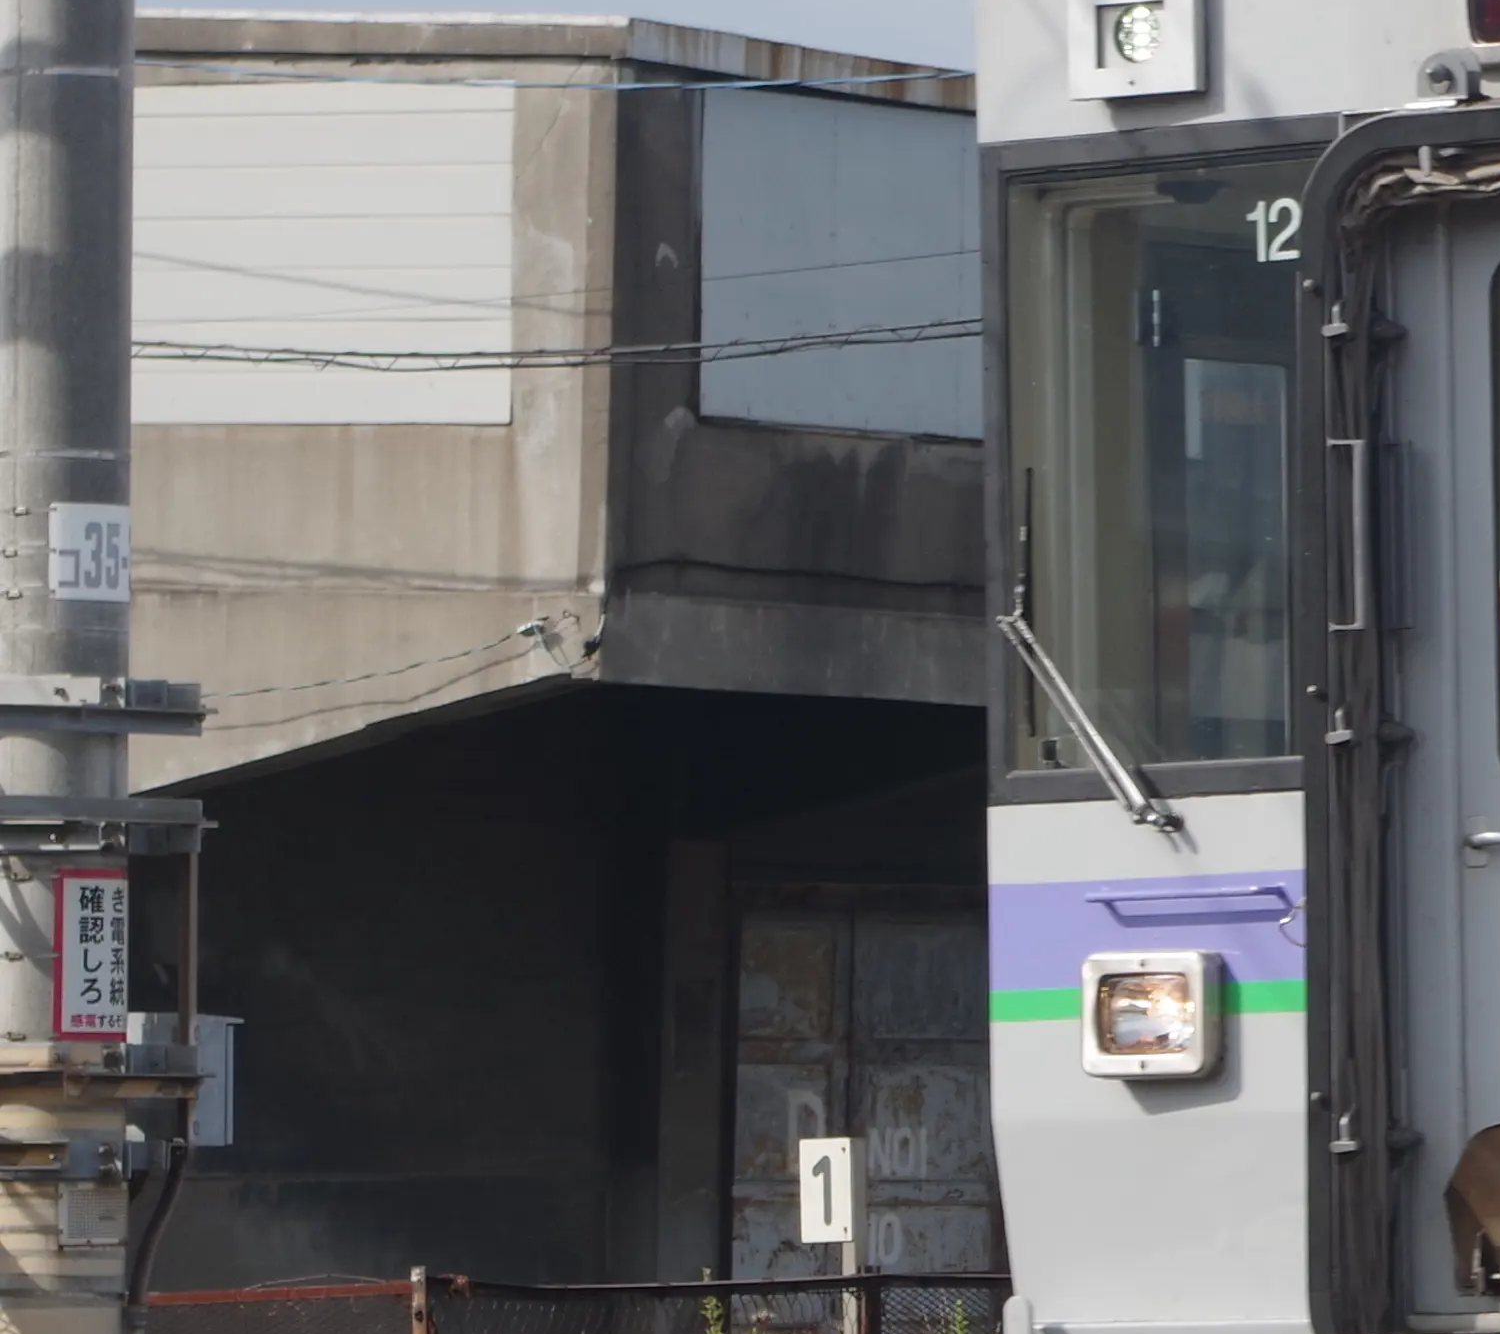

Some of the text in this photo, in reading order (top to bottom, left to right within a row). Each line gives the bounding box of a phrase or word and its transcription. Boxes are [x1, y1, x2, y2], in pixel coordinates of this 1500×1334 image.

[1245, 197, 1303, 262] 12
[78, 886, 105, 1006] 確認しろ
[812, 1154, 832, 1227] 1
